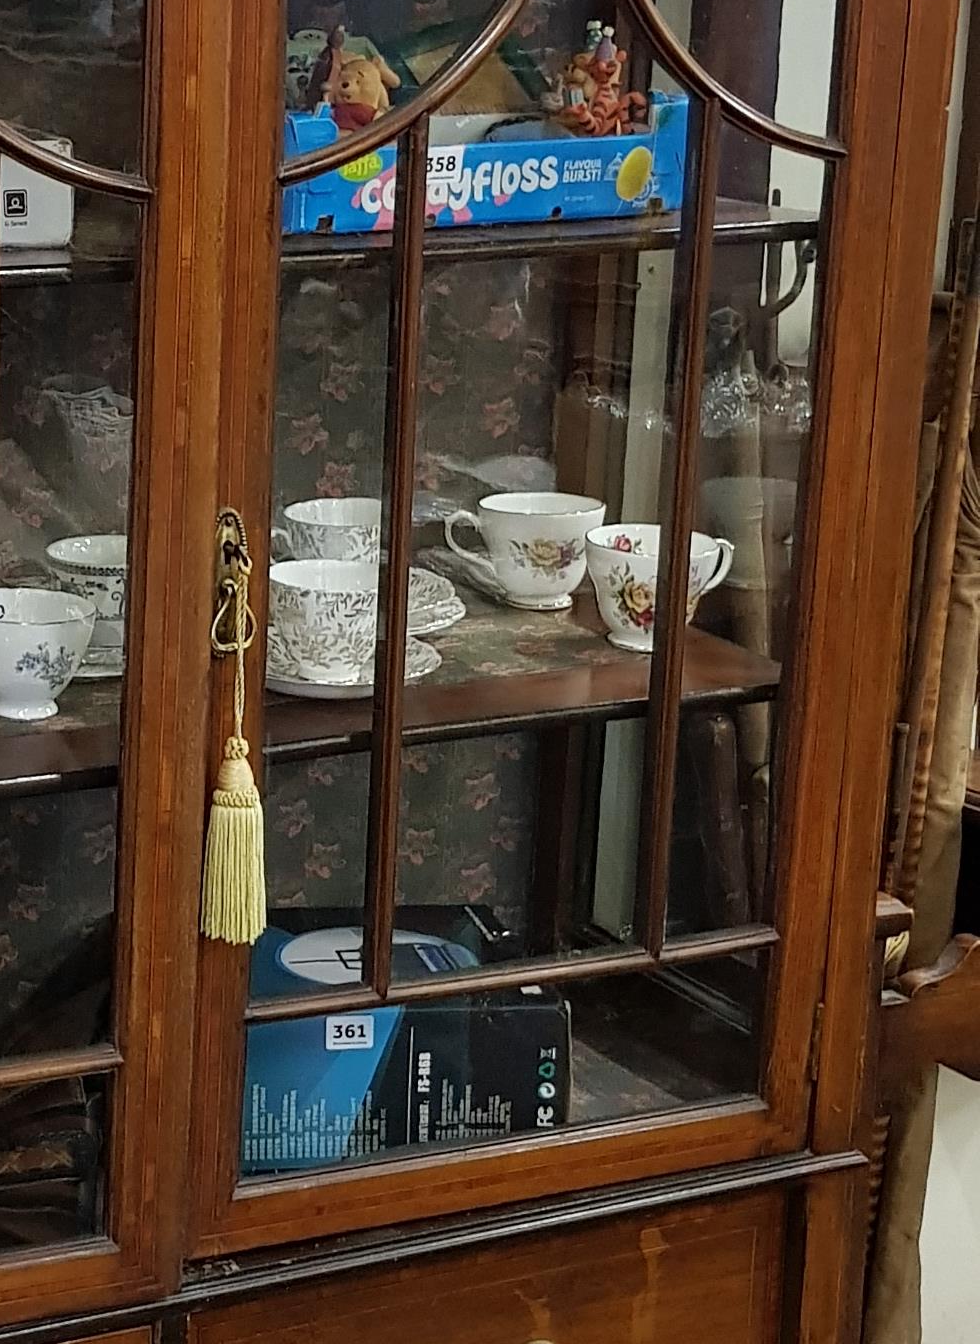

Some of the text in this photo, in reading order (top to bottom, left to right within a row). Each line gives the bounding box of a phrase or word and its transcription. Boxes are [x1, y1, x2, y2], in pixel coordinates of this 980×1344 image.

[426, 155, 456, 173] 358
[564, 159, 602, 170] FLAVOUR
[333, 1024, 367, 1039] 361
